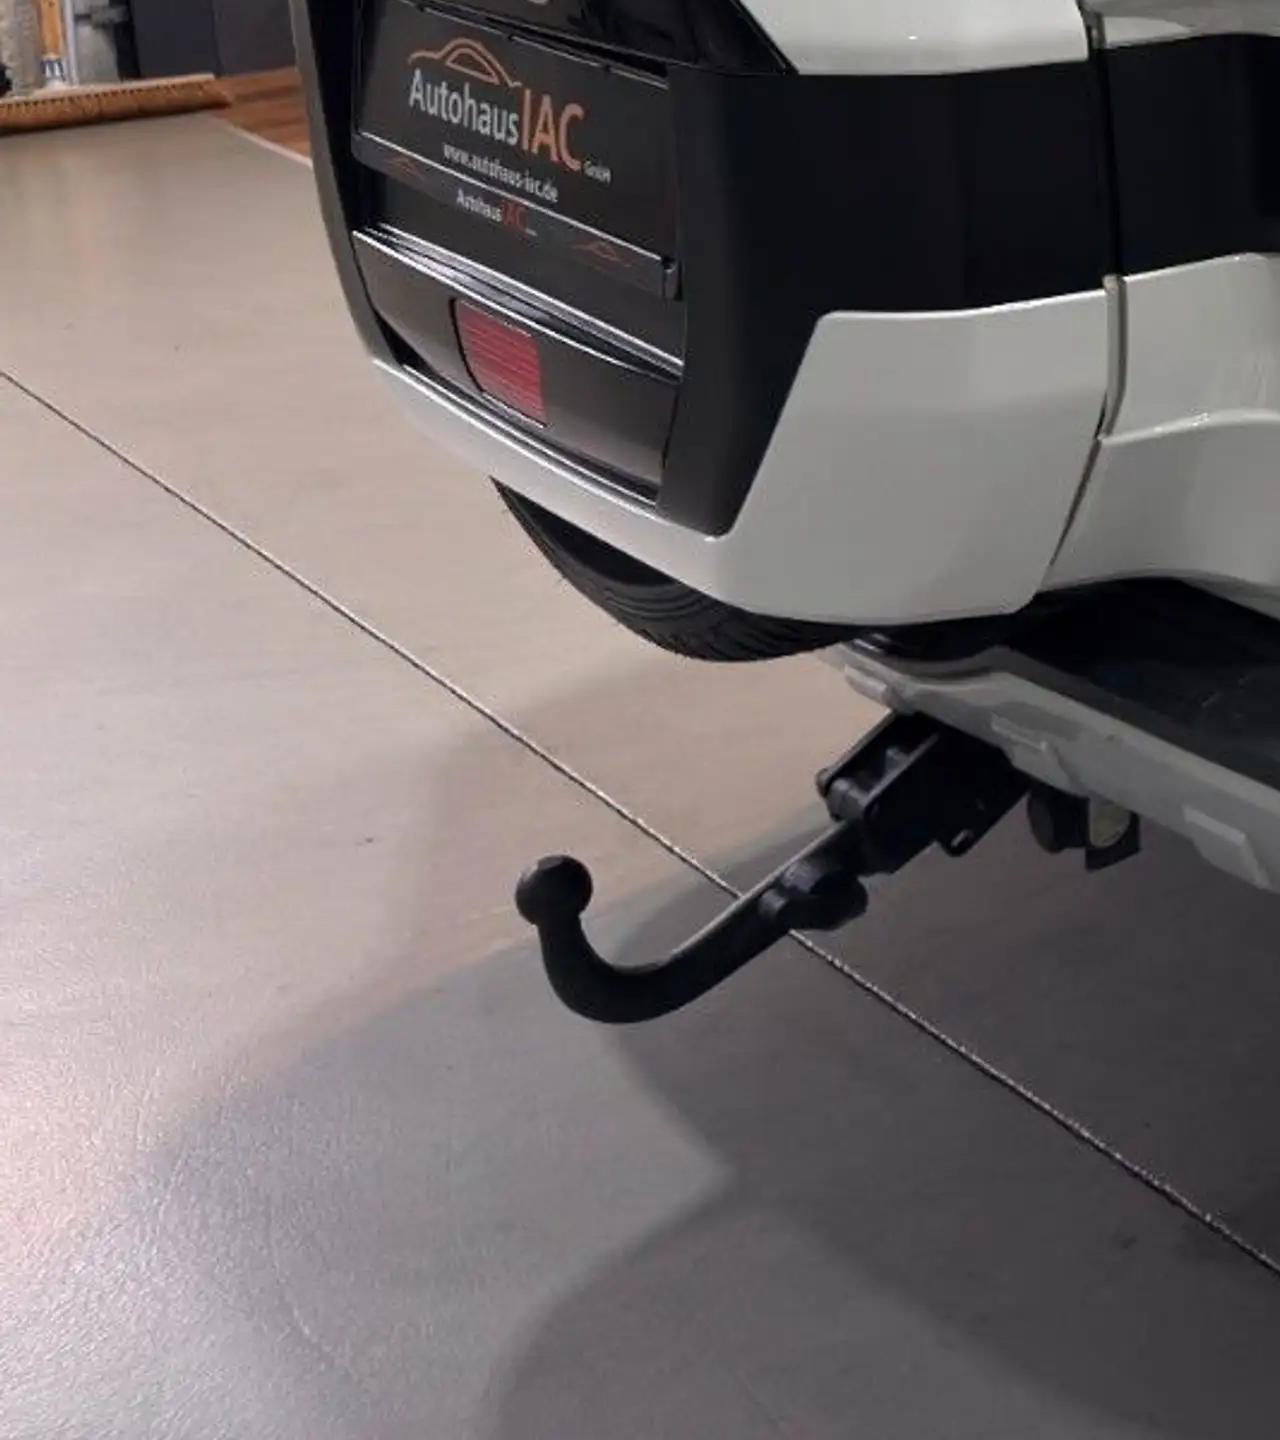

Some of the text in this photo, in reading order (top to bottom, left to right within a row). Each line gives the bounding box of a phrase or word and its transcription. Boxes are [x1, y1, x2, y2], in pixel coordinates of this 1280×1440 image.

[408, 68, 519, 146] Autohaus
[519, 88, 585, 171] IAC
[442, 142, 559, 203] www.autohaus-iac.de
